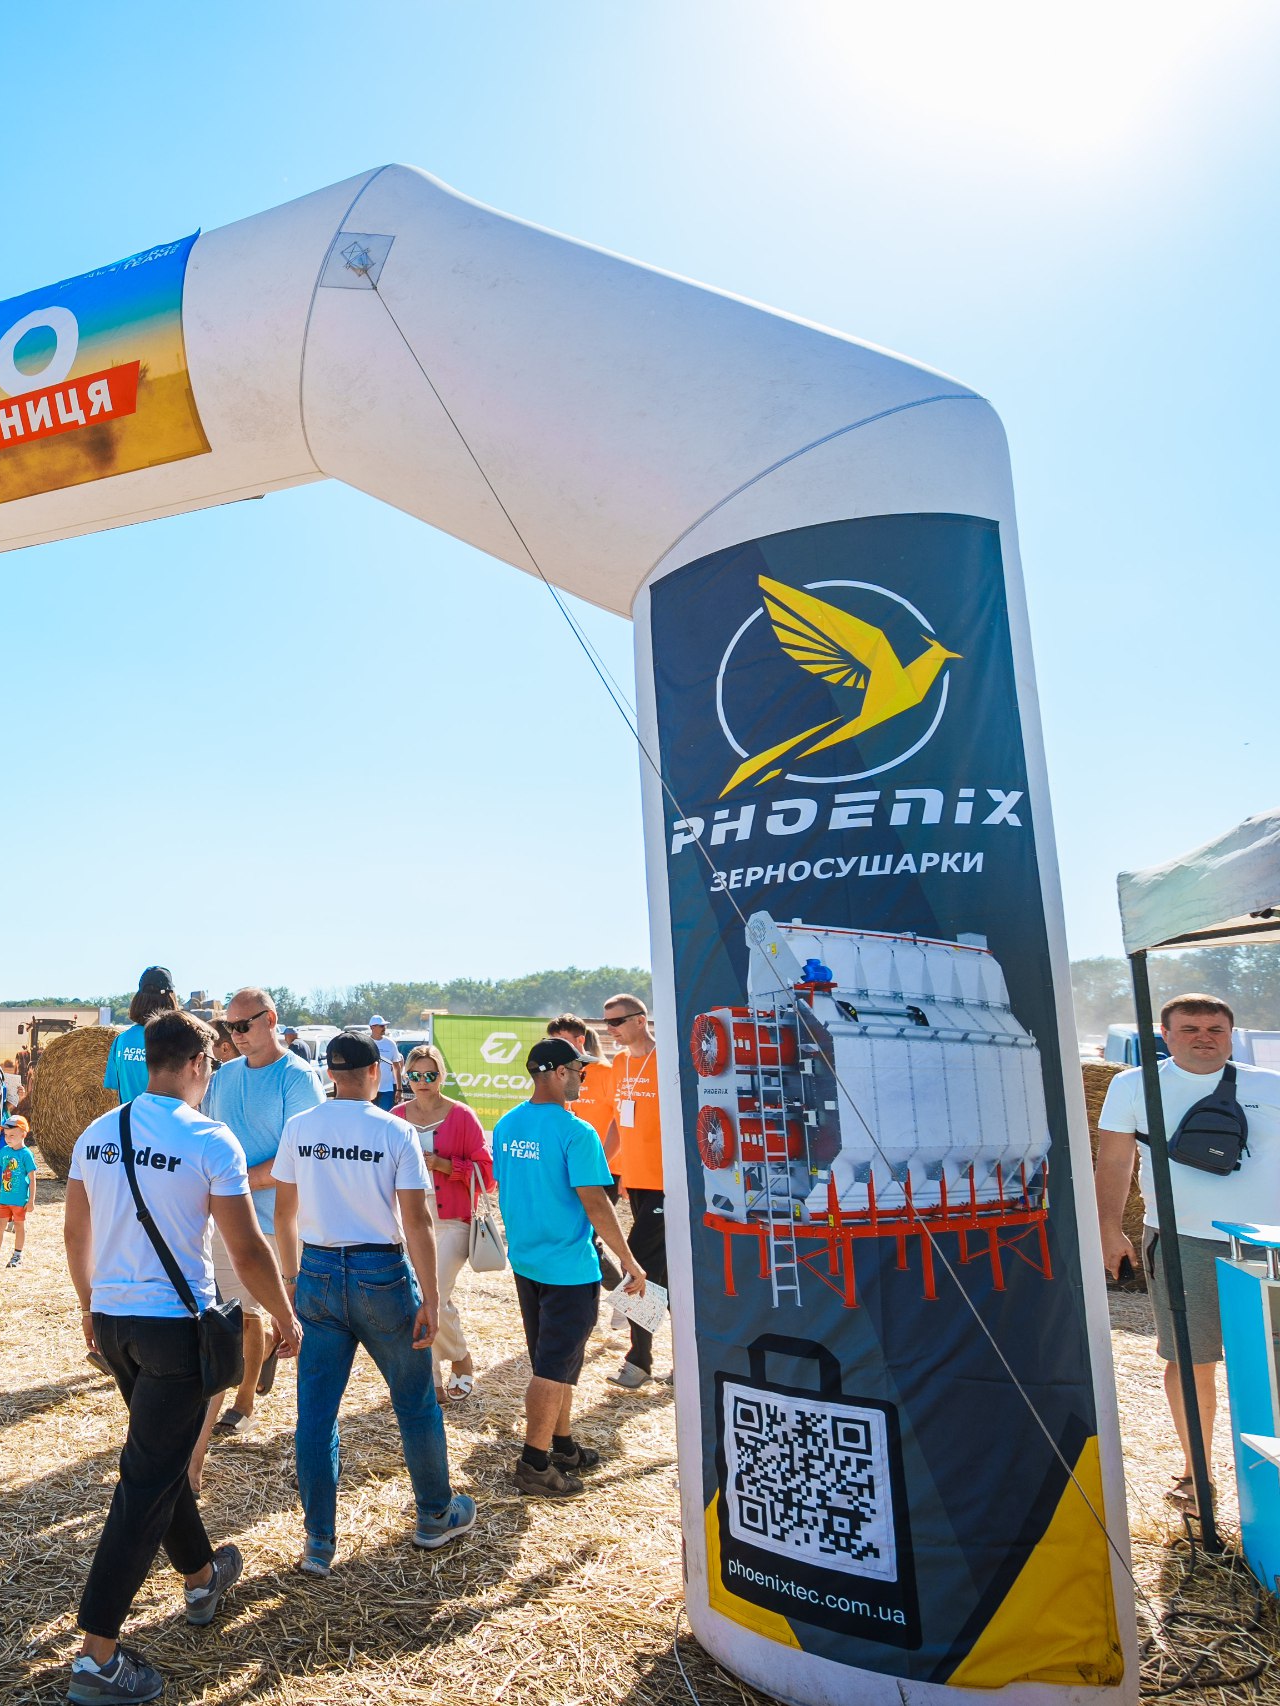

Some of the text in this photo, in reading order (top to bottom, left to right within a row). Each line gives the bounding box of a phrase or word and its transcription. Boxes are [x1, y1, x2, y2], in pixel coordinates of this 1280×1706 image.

[710, 852, 984, 892] ЗЕРНОСУШАРКИ
[298, 1142, 384, 1163] wonder
[509, 1147, 537, 1160] TEAM
[510, 1139, 536, 1150] AGRO
[728, 1558, 907, 1626] phoenixtec.com.ua
